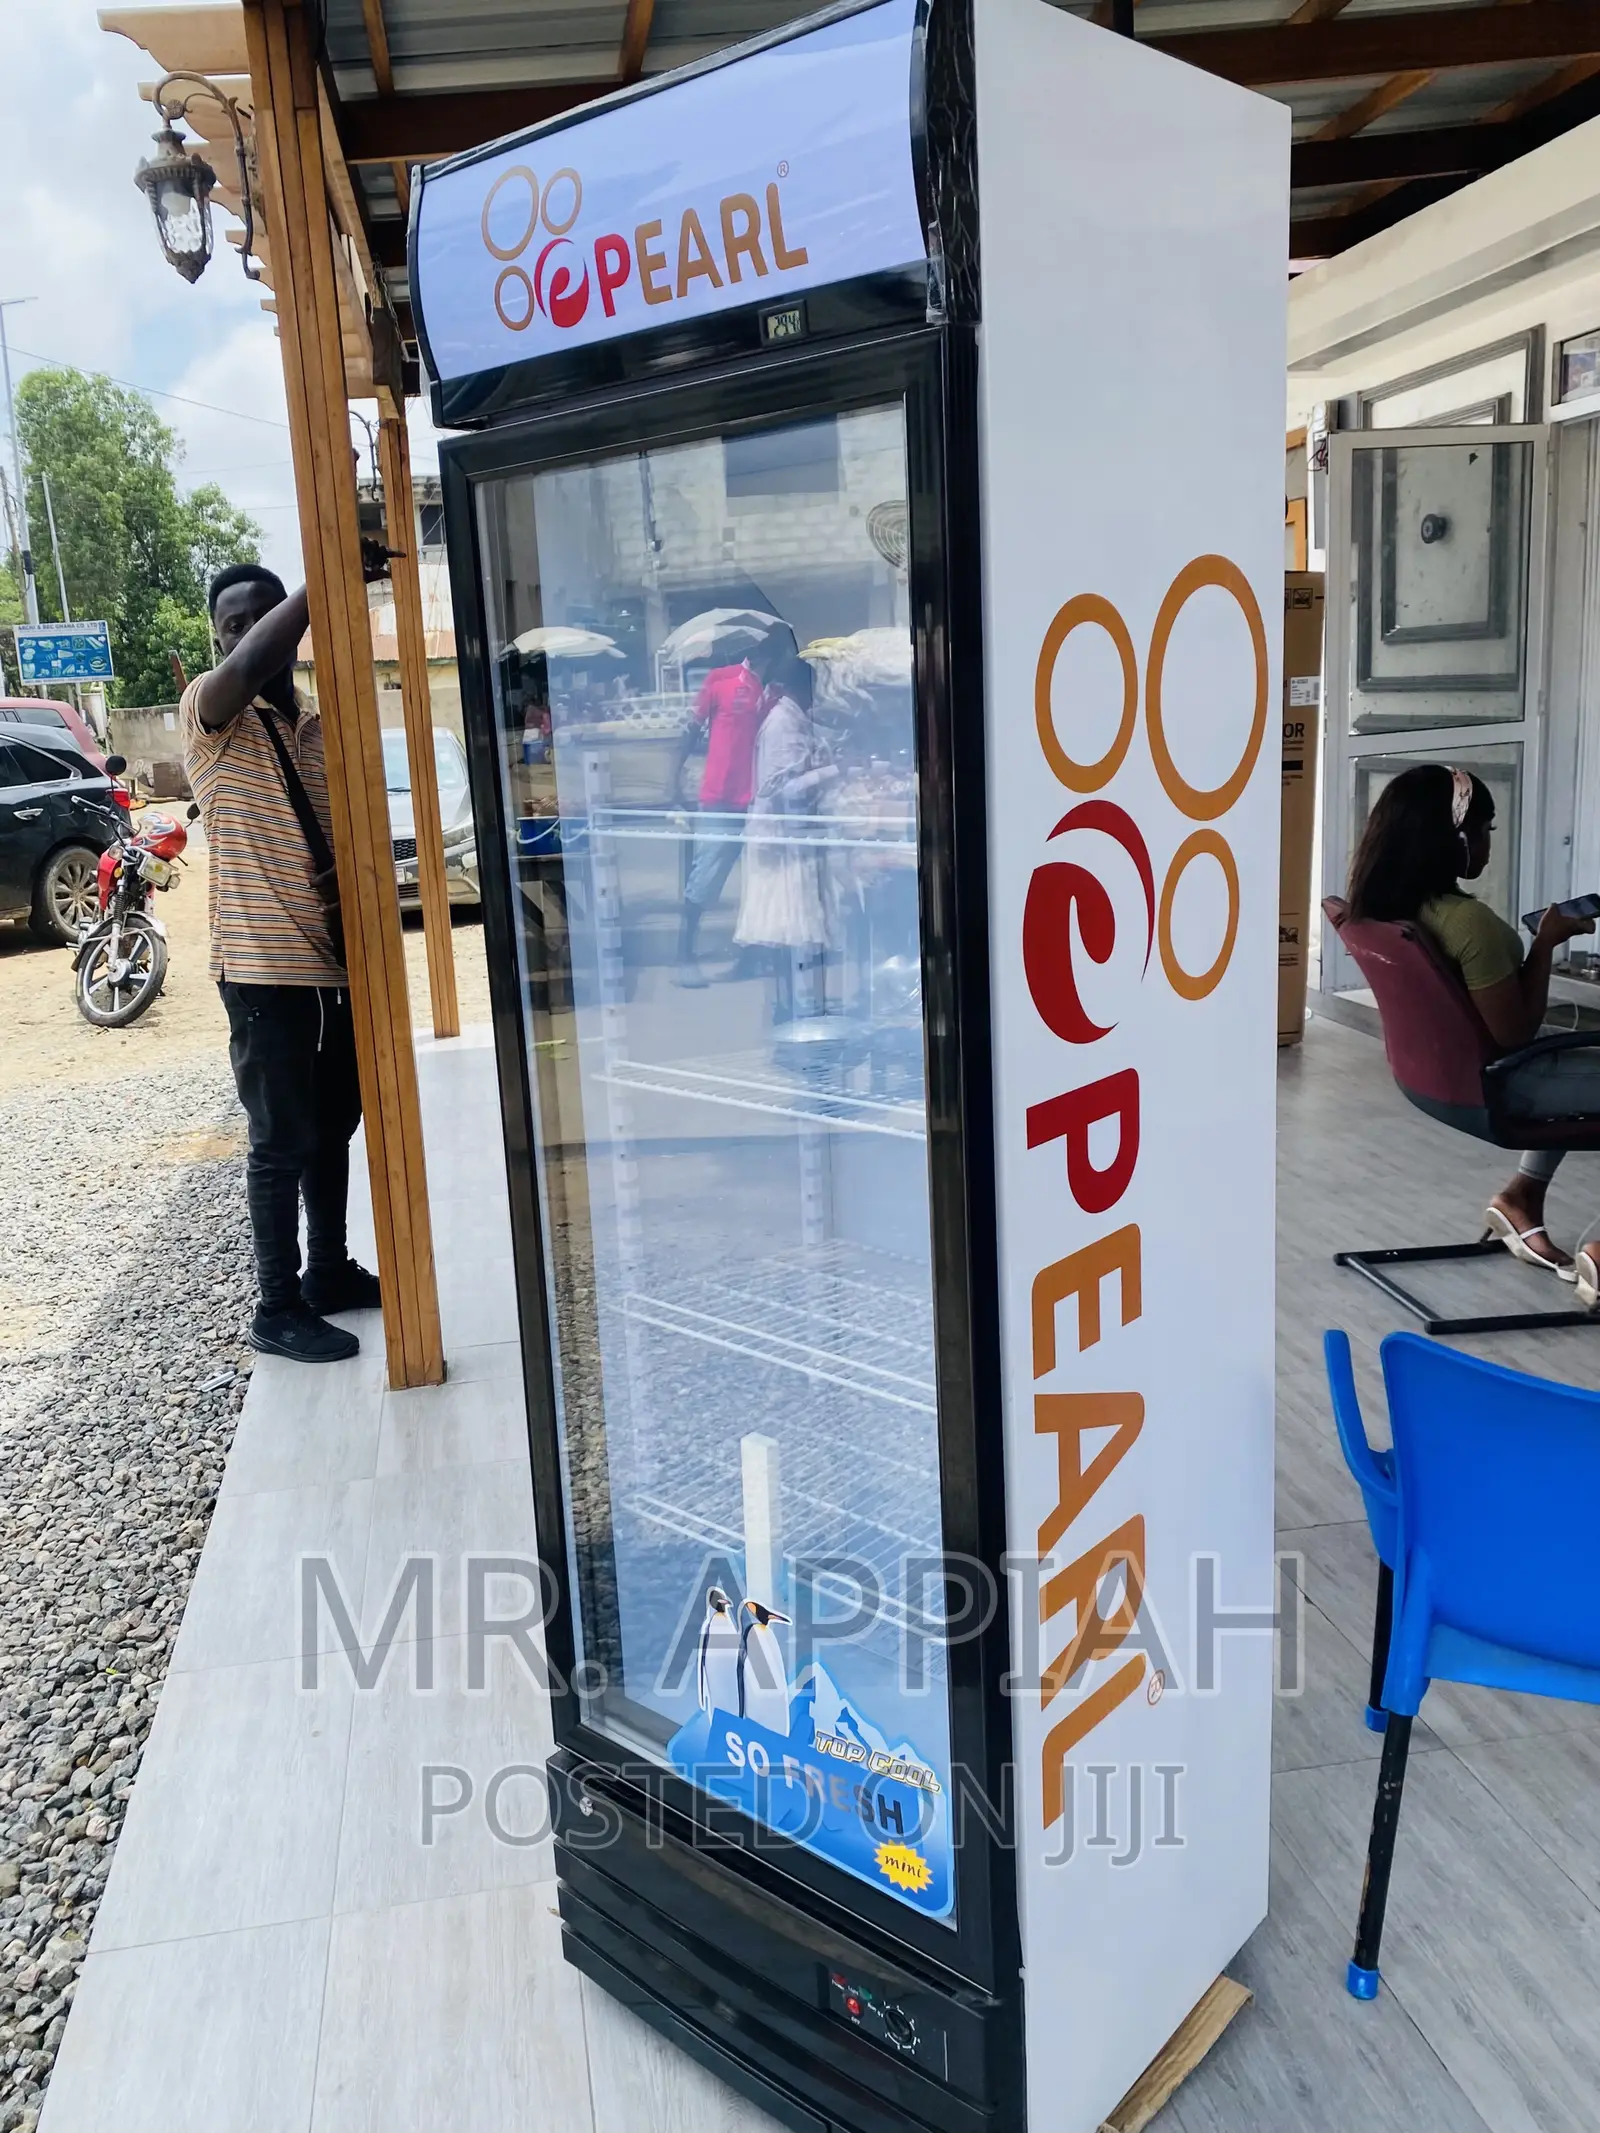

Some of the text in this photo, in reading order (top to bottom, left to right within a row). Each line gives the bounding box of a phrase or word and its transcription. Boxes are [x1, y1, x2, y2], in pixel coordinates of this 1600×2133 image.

[594, 182, 809, 318] PEARL
[1026, 1067, 1145, 1830] PEARL
[724, 1731, 904, 1835] SO FRESH
[816, 1731, 941, 1792] TOP COOL
[885, 1854, 923, 1879] mini
